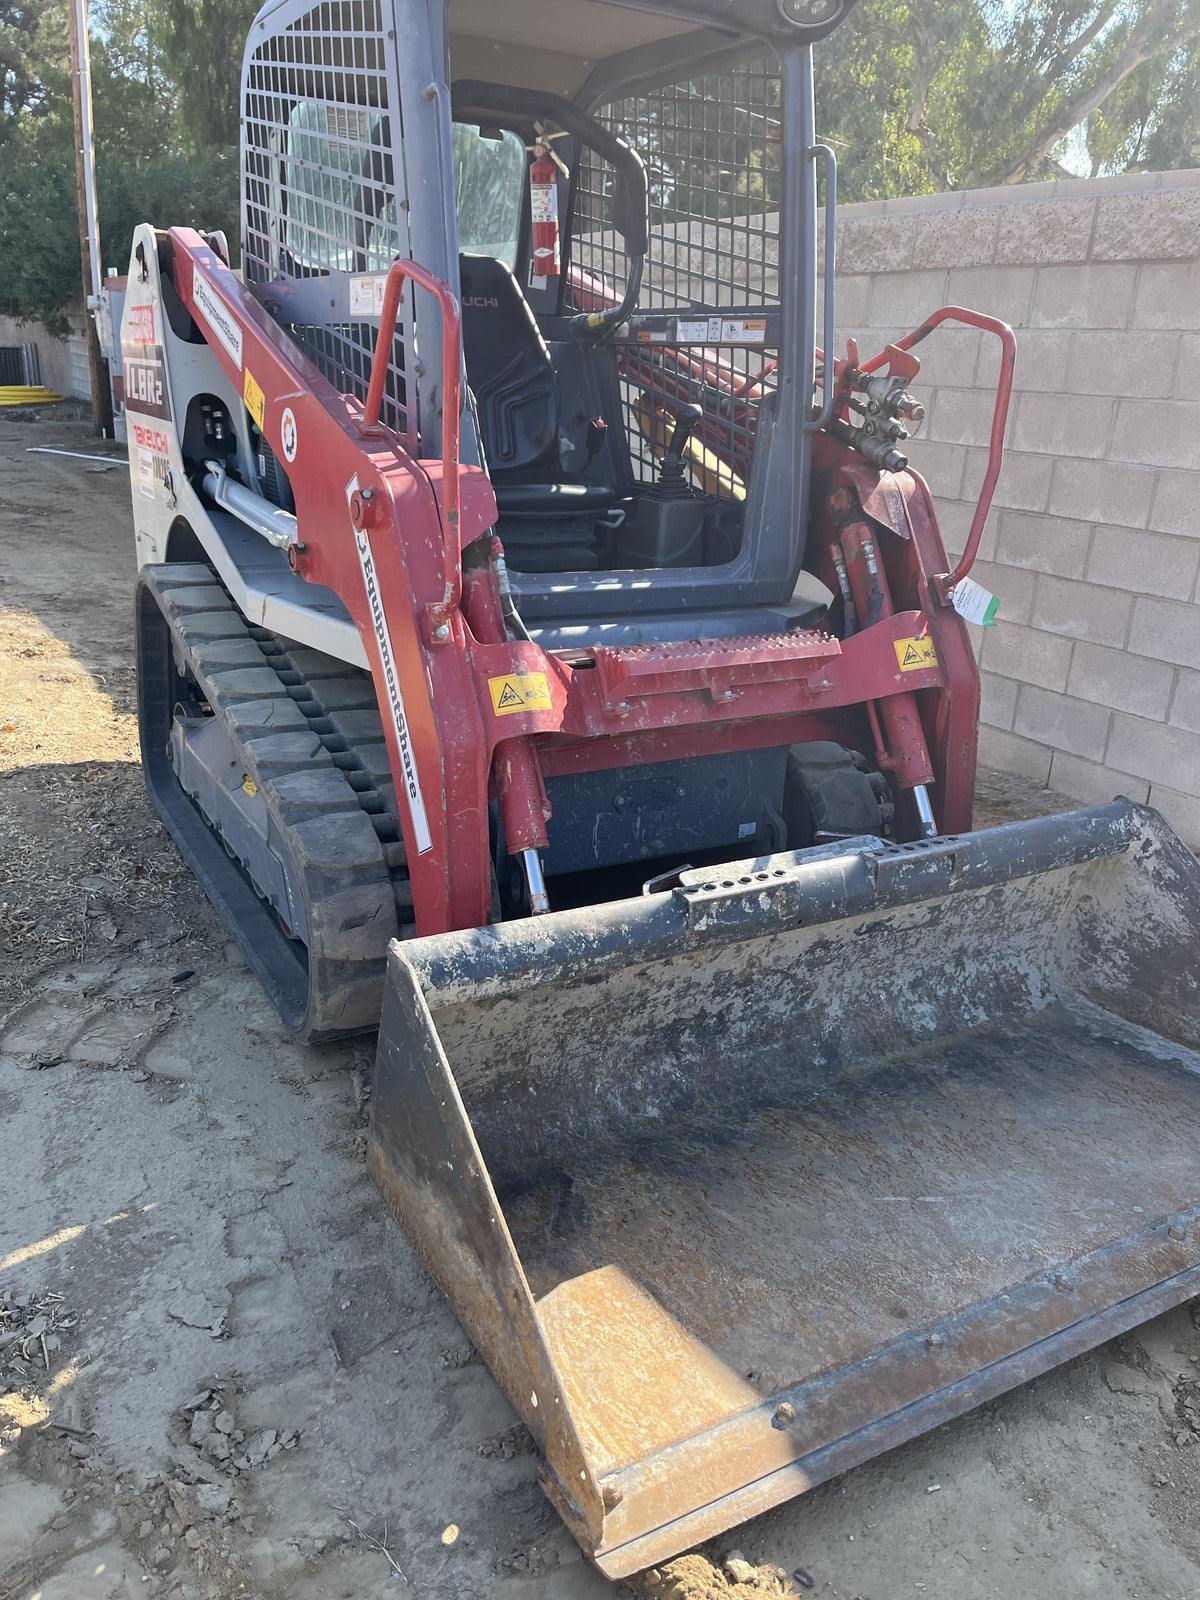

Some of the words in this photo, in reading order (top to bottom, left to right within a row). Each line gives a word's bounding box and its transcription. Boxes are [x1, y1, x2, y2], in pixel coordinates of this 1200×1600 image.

[462, 296, 499, 307] UCHI
[133, 425, 169, 454] TAKEUCHI
[363, 555, 417, 800] EquipmentShare
